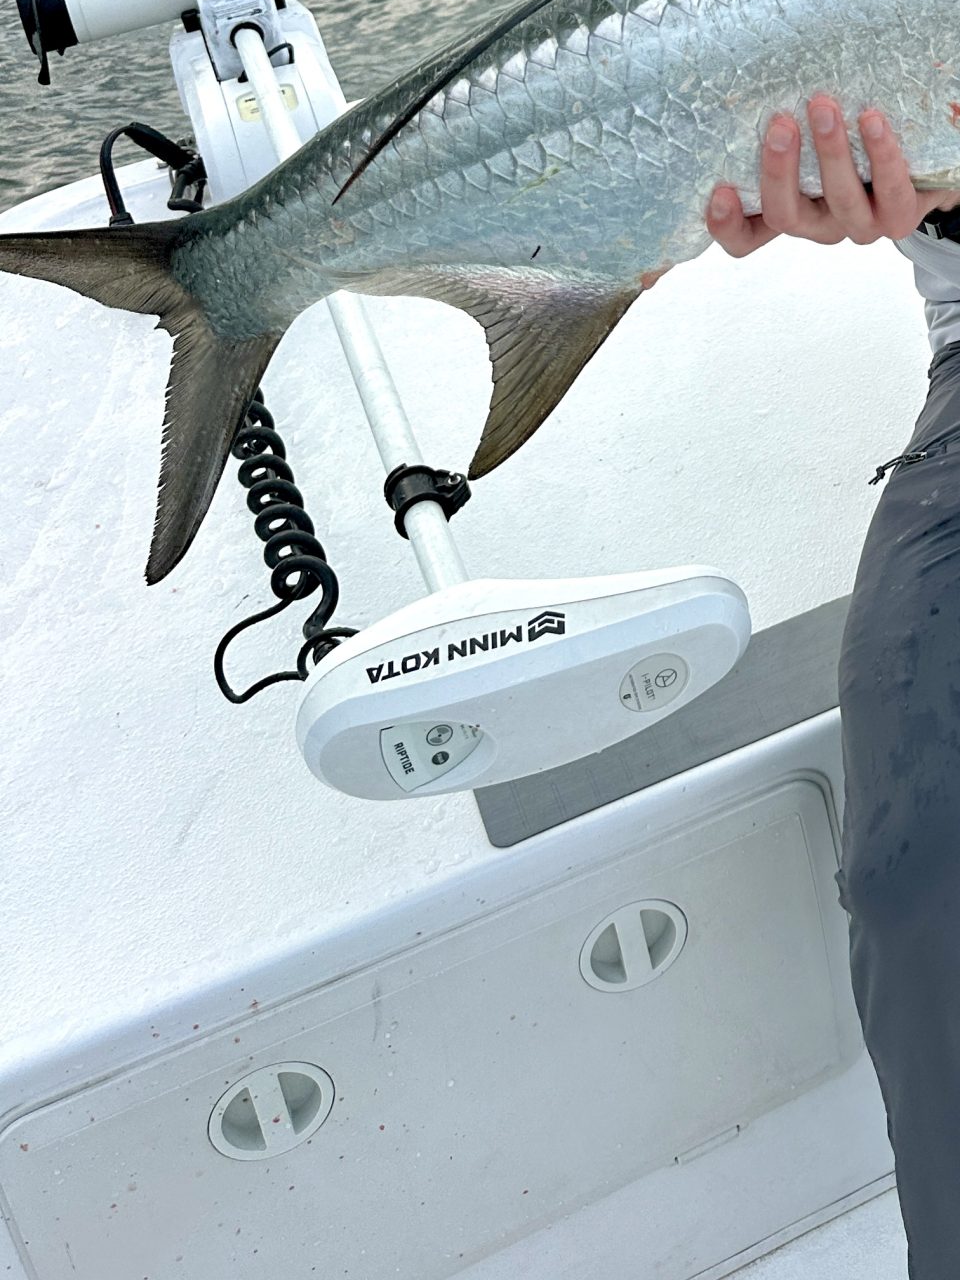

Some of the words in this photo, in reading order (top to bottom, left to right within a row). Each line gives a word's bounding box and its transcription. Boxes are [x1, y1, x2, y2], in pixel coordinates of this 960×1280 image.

[448, 625, 523, 661] MINN
[366, 647, 440, 684] KOTA
[394, 741, 415, 775] RIPTIDE
